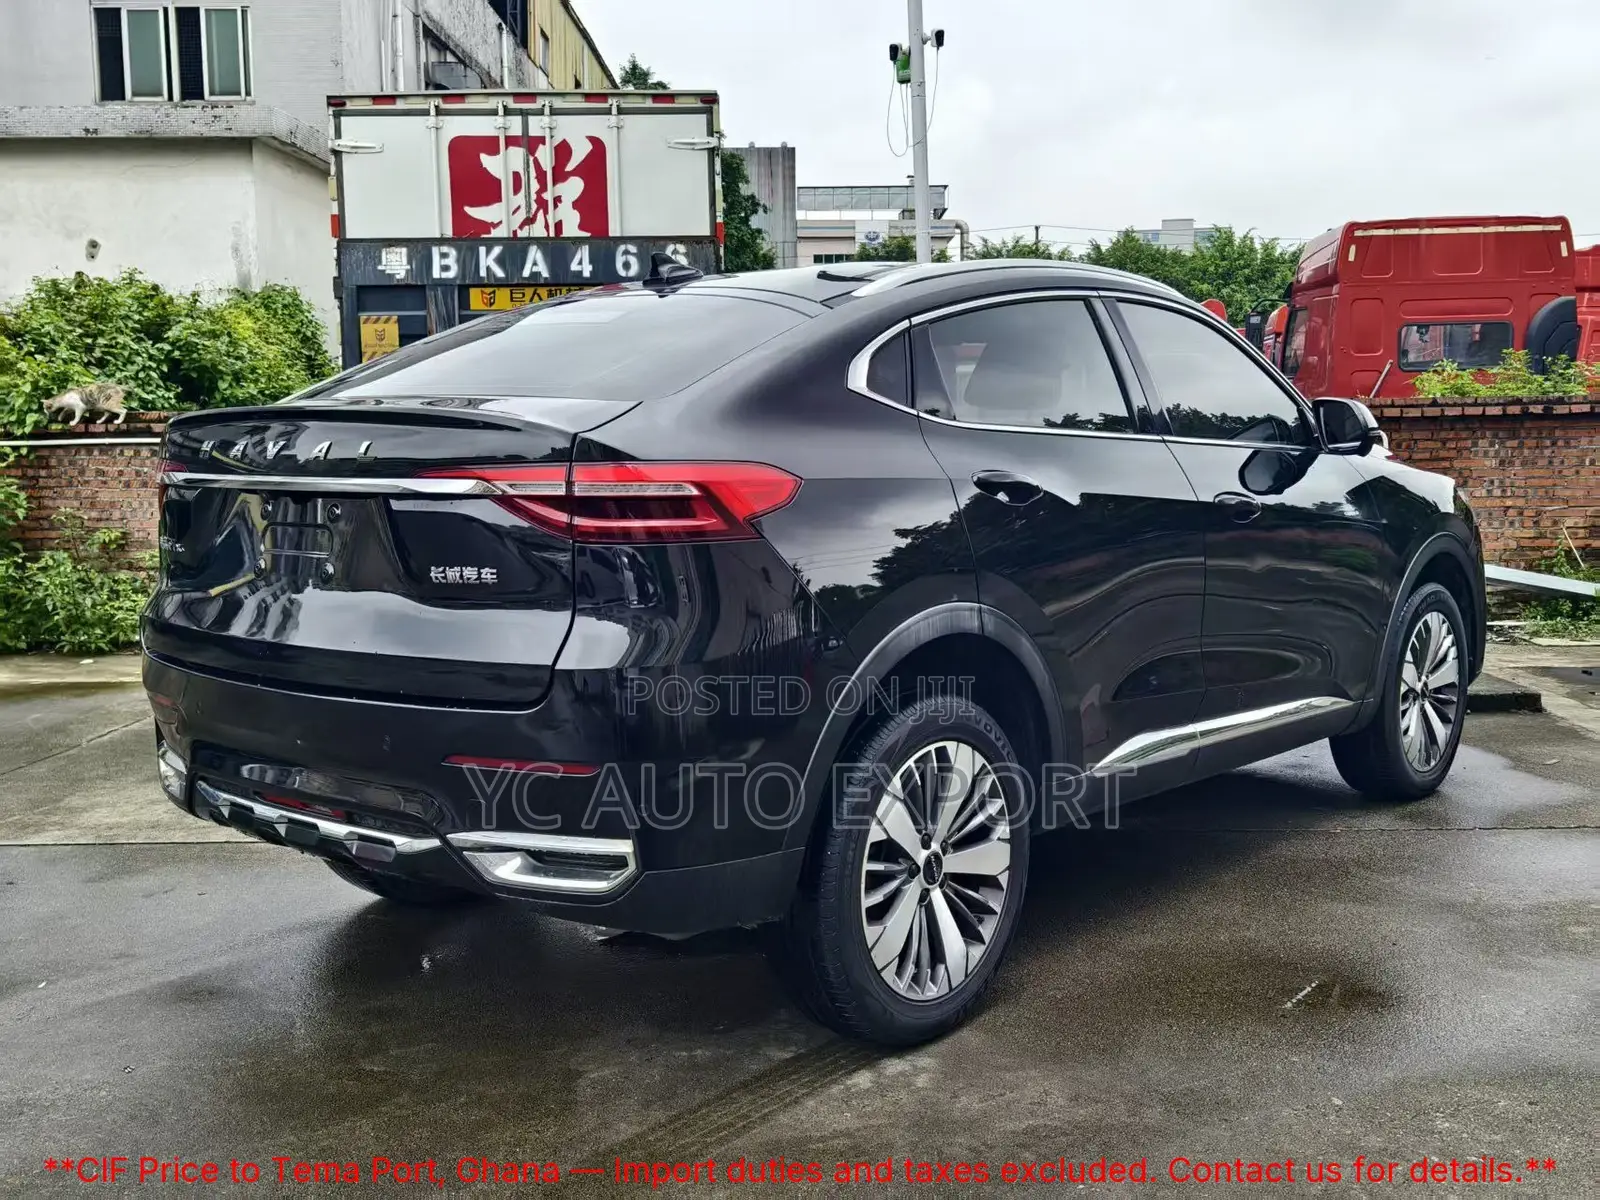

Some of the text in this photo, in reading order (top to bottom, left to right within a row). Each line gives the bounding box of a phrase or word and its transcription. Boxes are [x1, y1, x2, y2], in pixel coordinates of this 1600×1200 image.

[199, 440, 377, 463] HAVAL
[430, 566, 498, 584] 长城汽车
